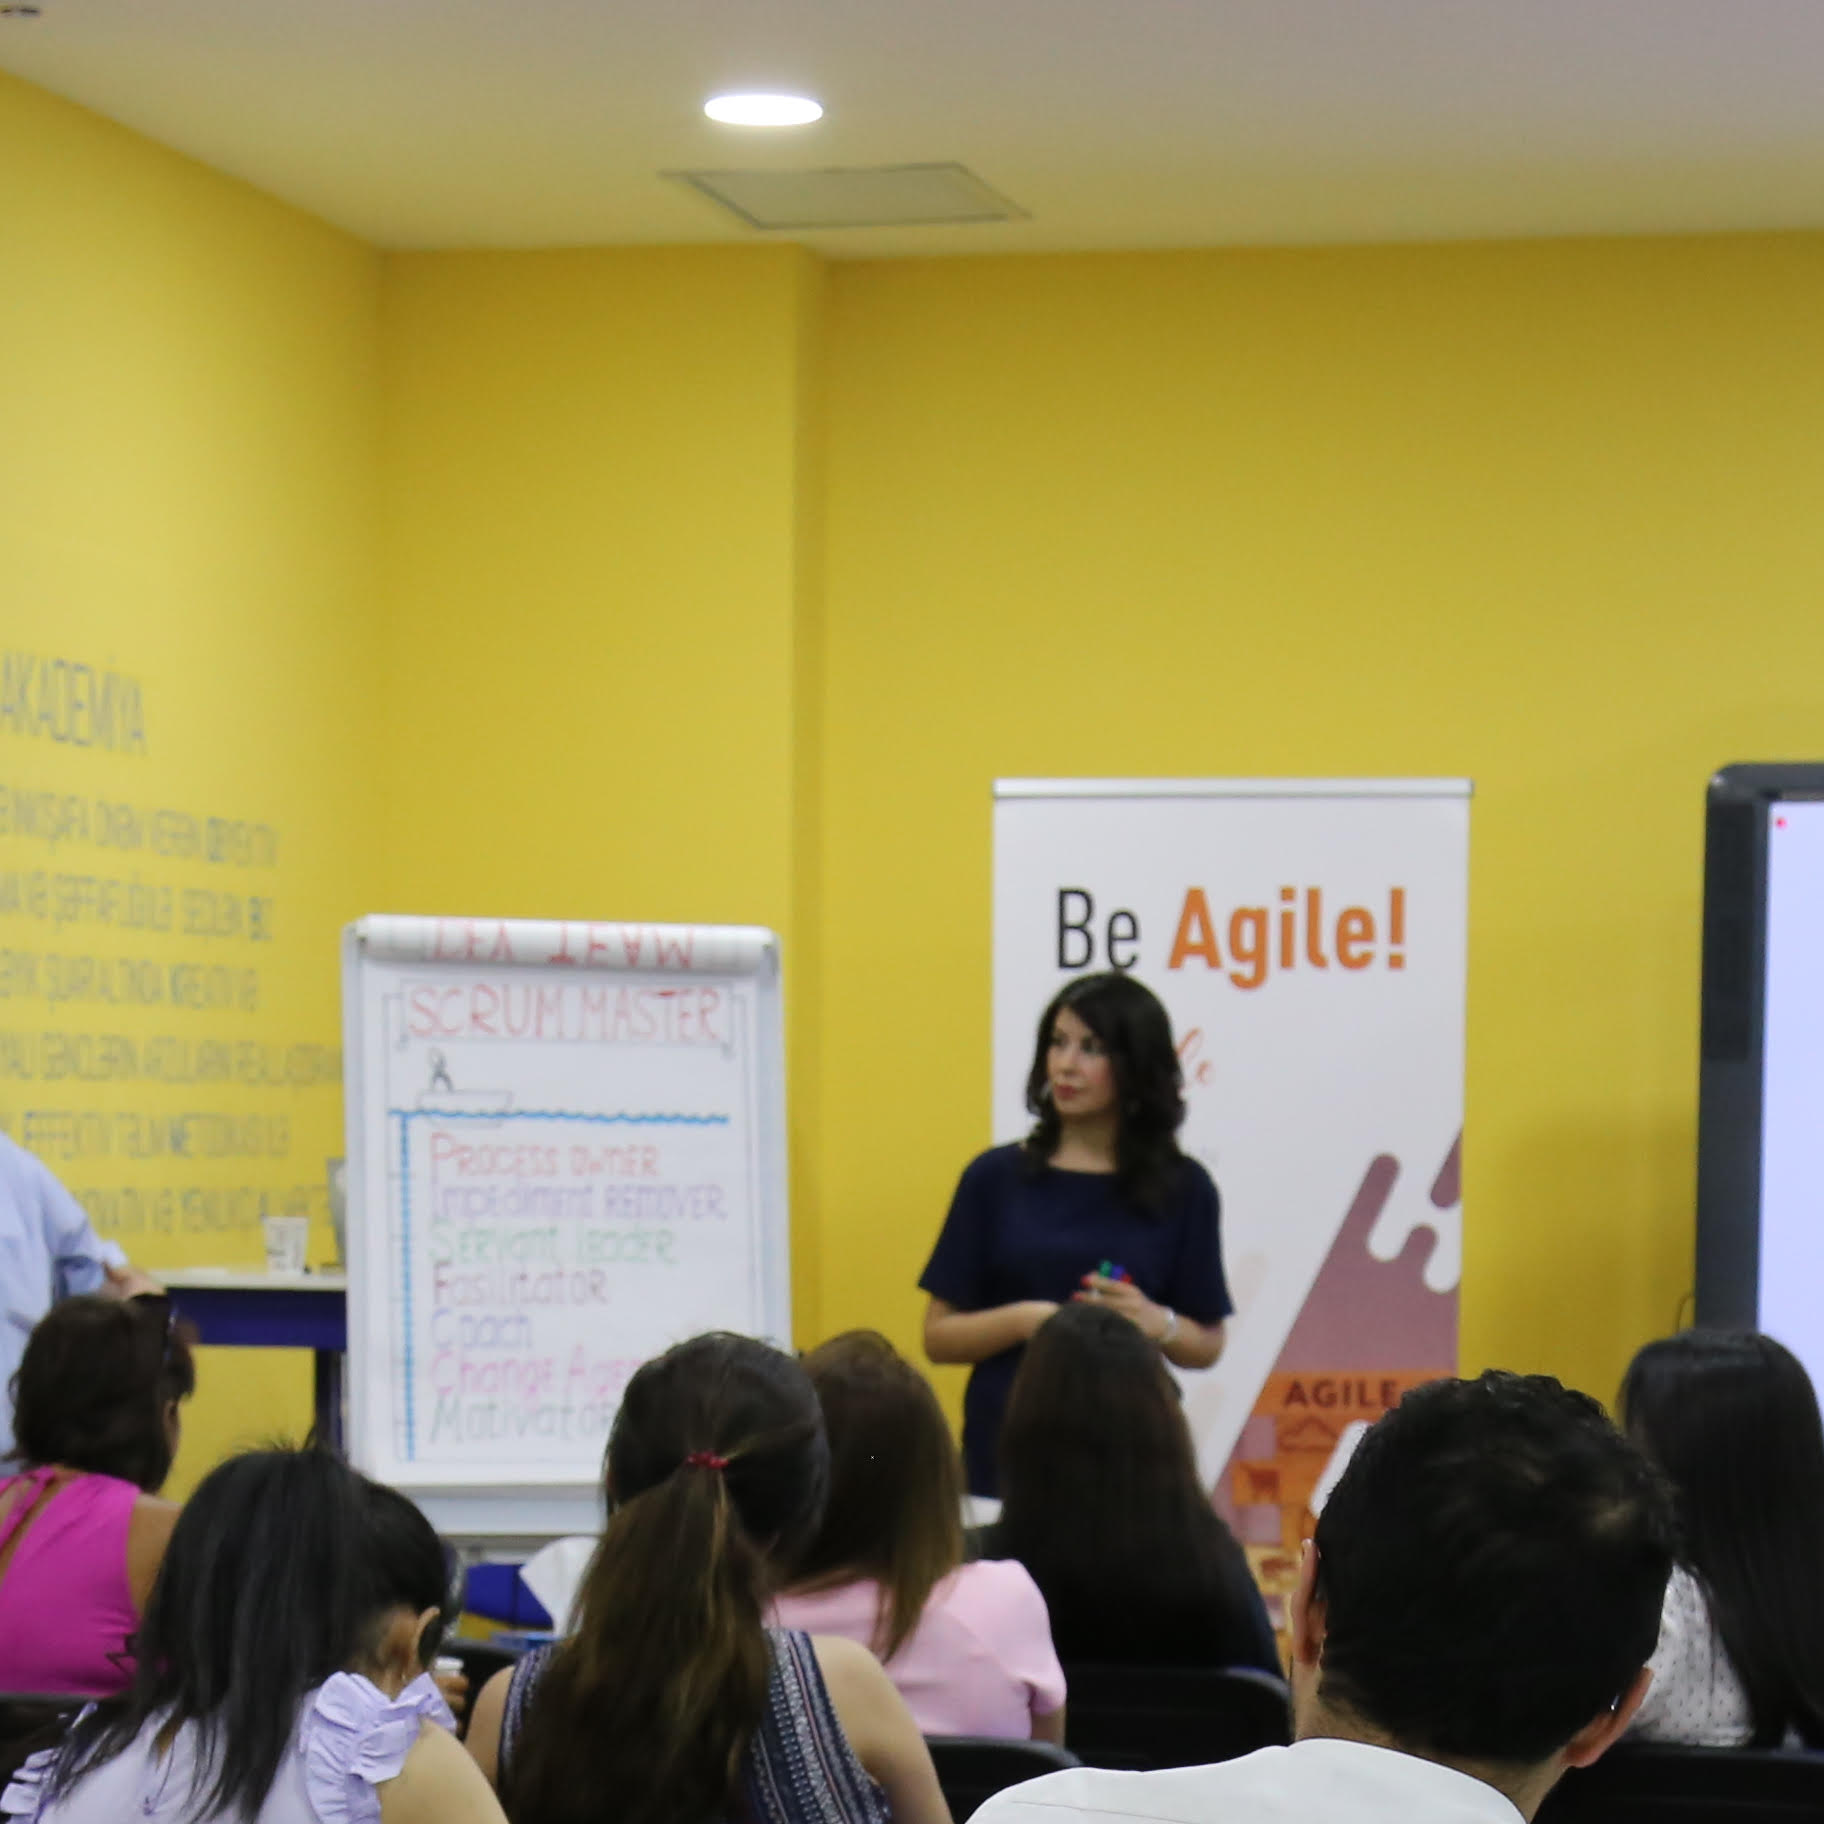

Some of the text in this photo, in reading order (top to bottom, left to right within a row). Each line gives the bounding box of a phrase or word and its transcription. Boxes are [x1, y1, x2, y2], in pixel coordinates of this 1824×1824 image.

[1057, 886, 1406, 990] Be Agile!
[409, 983, 721, 1042] SCRUM MASTER
[1283, 1379, 1397, 1408] AGILE
